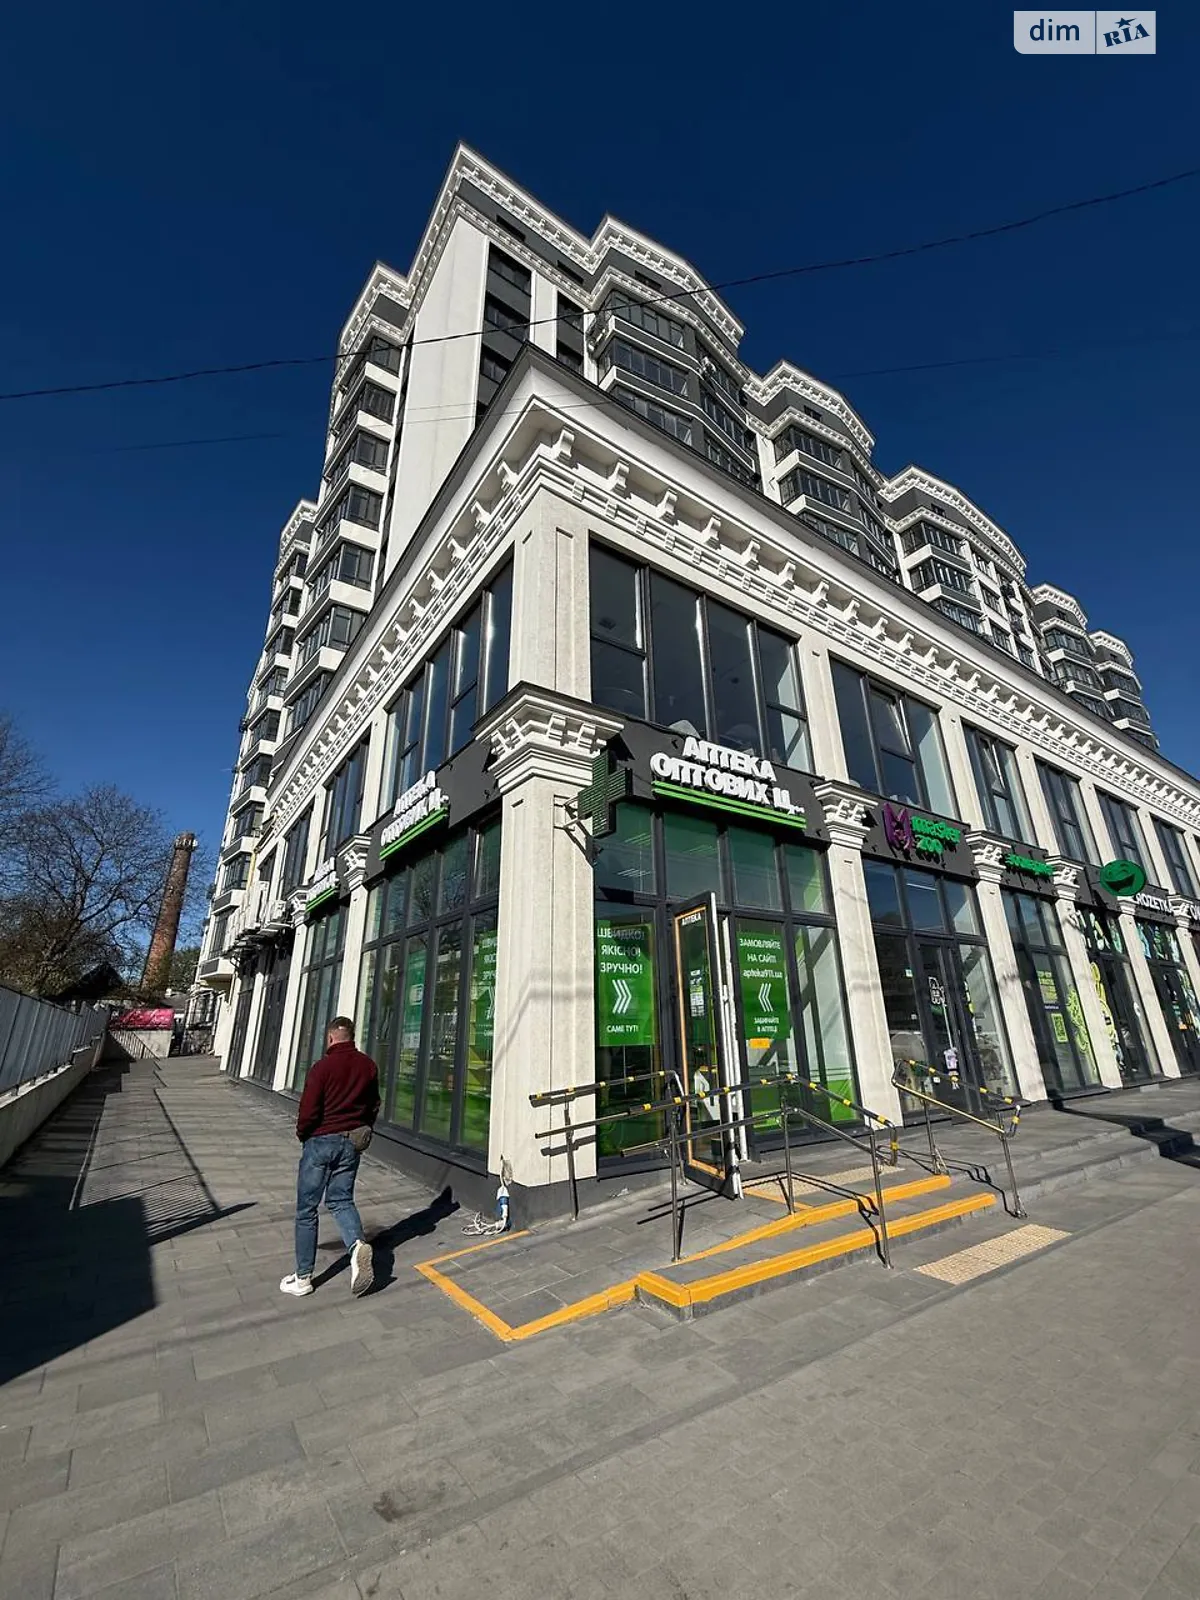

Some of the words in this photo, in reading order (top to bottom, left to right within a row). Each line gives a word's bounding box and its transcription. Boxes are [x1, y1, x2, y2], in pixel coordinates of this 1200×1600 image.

[682, 736, 777, 782] АПТЕКА
[650, 752, 770, 805] ОПТОВИХ
[600, 962, 643, 974] ЗРУЧНО!
[606, 1024, 625, 1033] САМЕ
